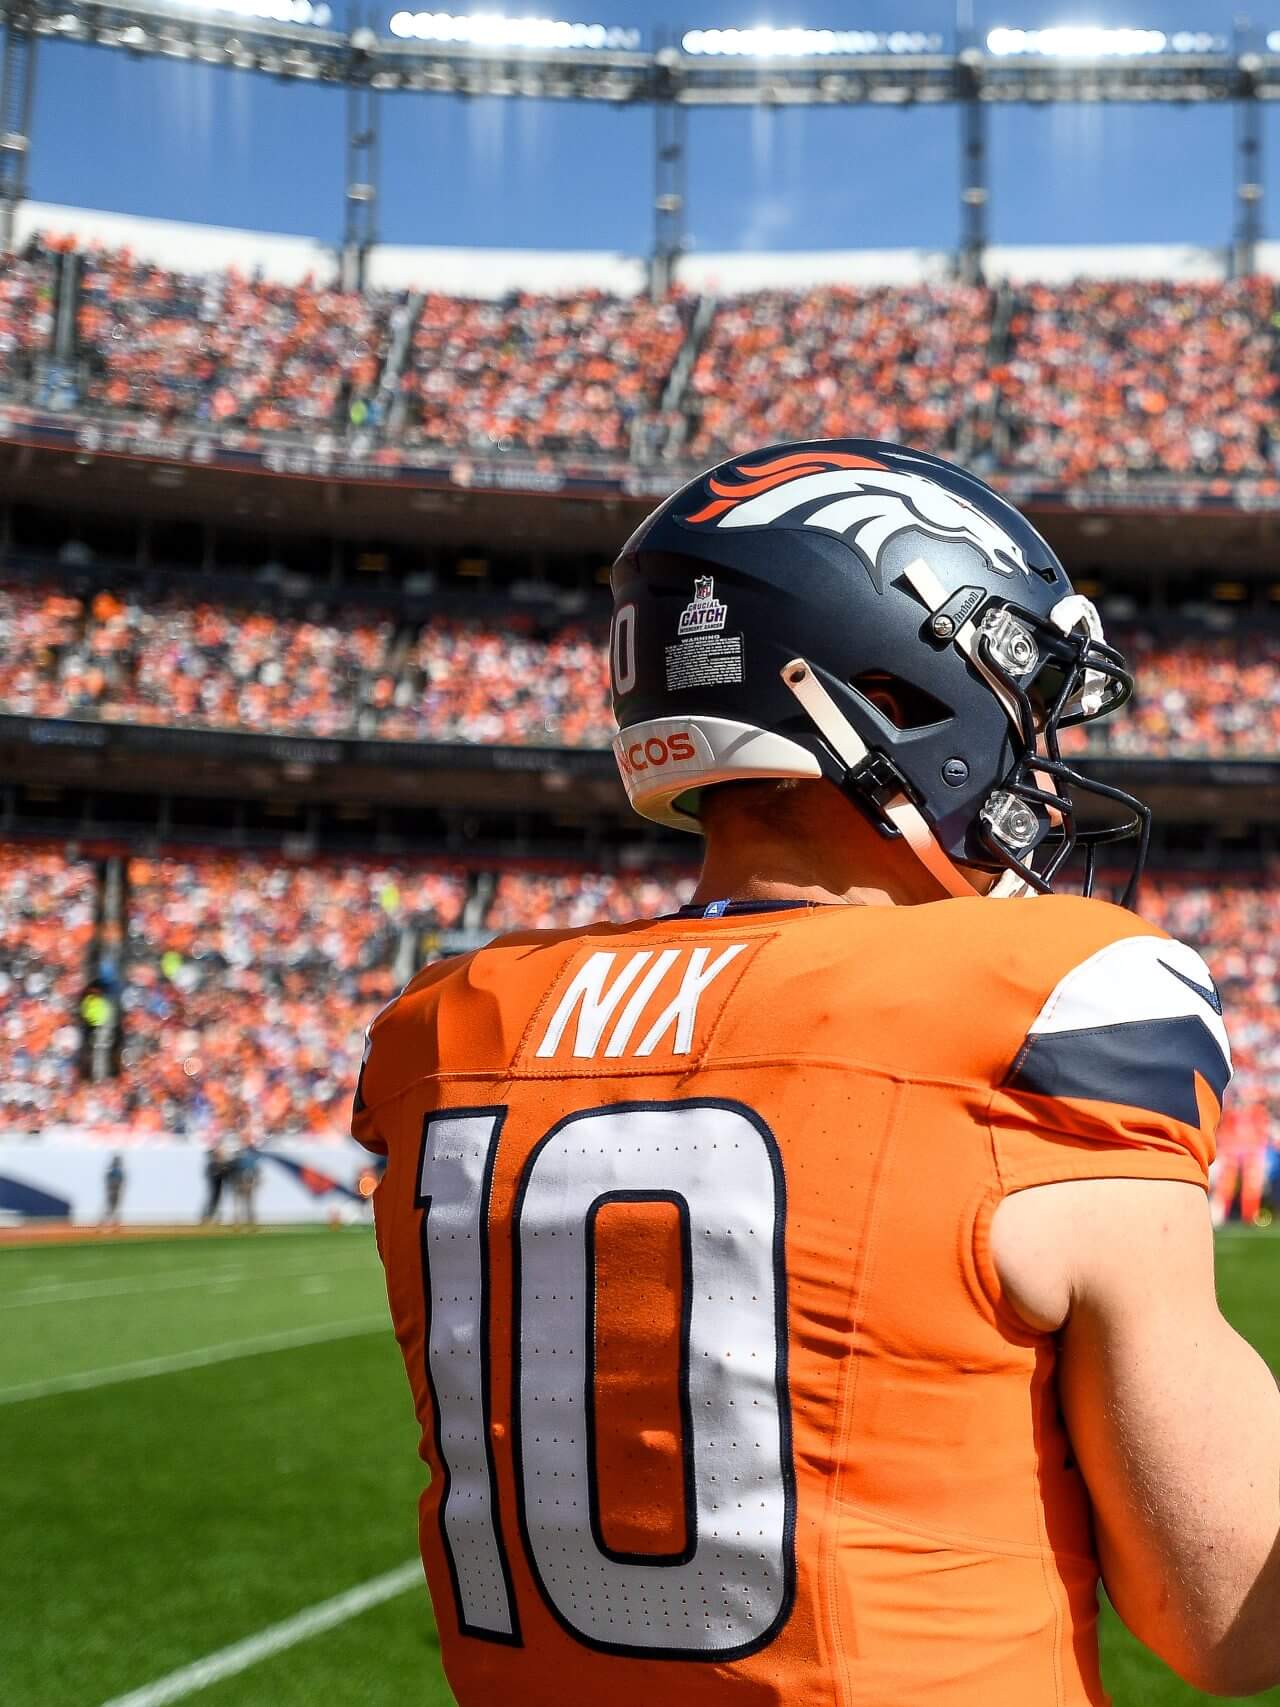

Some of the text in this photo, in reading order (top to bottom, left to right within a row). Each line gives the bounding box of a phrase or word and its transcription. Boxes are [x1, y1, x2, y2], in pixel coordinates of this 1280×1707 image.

[681, 607, 725, 626] CATCH
[688, 600, 719, 611] CRUCIAL
[953, 591, 979, 624] Riddell
[681, 634, 720, 643] WARNING
[535, 944, 748, 1059] NIX
[415, 1097, 797, 1663] 10
